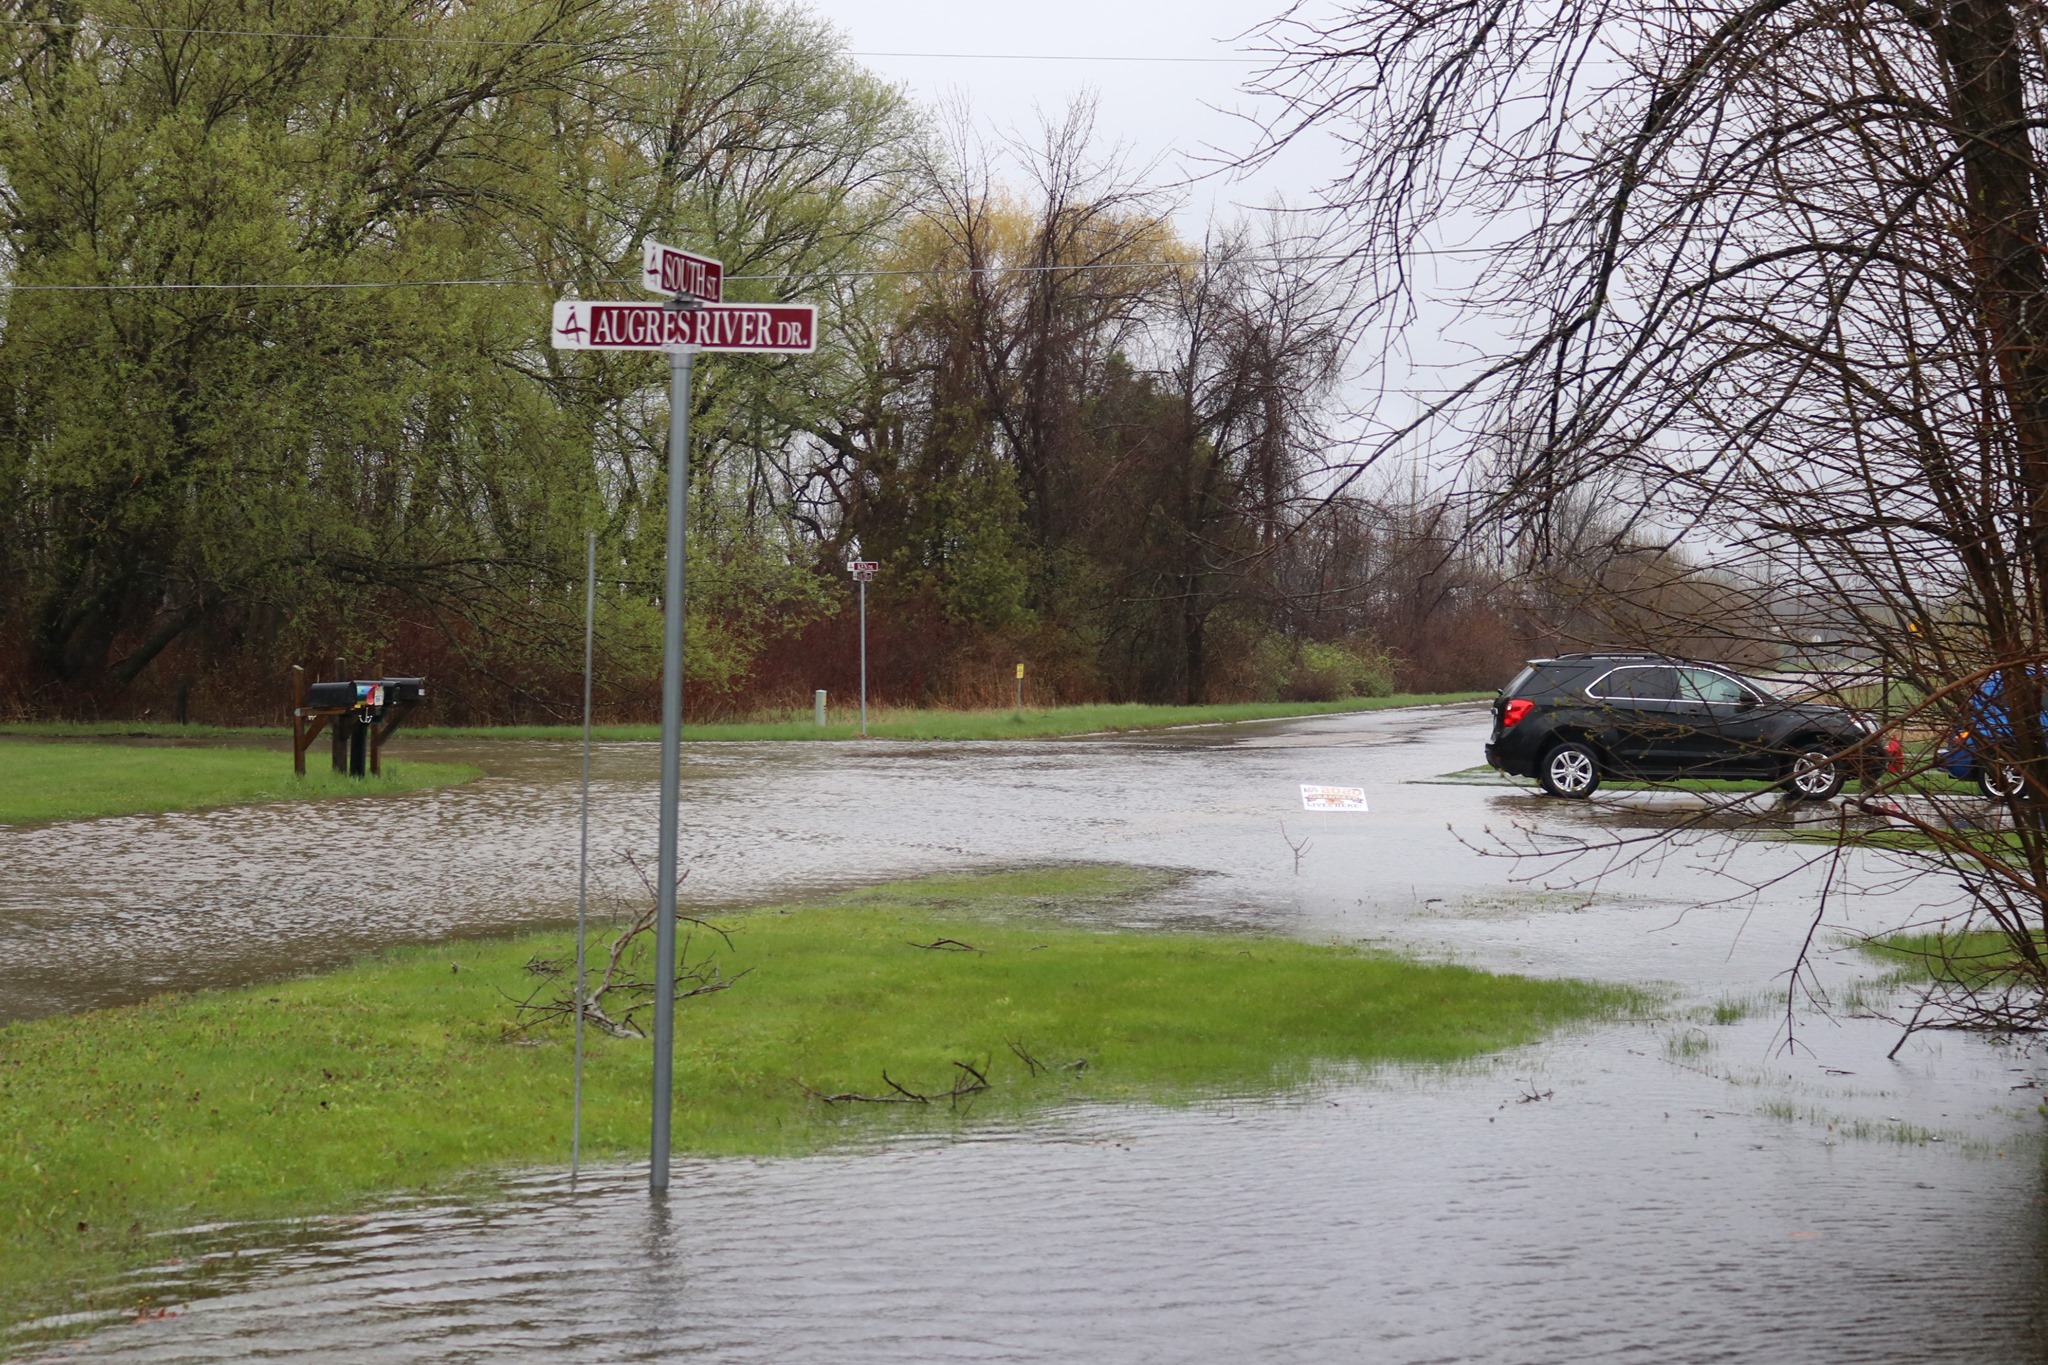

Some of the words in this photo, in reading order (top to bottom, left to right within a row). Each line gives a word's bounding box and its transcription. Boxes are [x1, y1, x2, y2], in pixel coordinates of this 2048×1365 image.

[664, 254, 706, 296] SOUTH
[594, 309, 691, 344] AUGRES
[695, 310, 773, 345] RIVER
[777, 320, 808, 346] DR.
[1321, 787, 1362, 796] 2020
